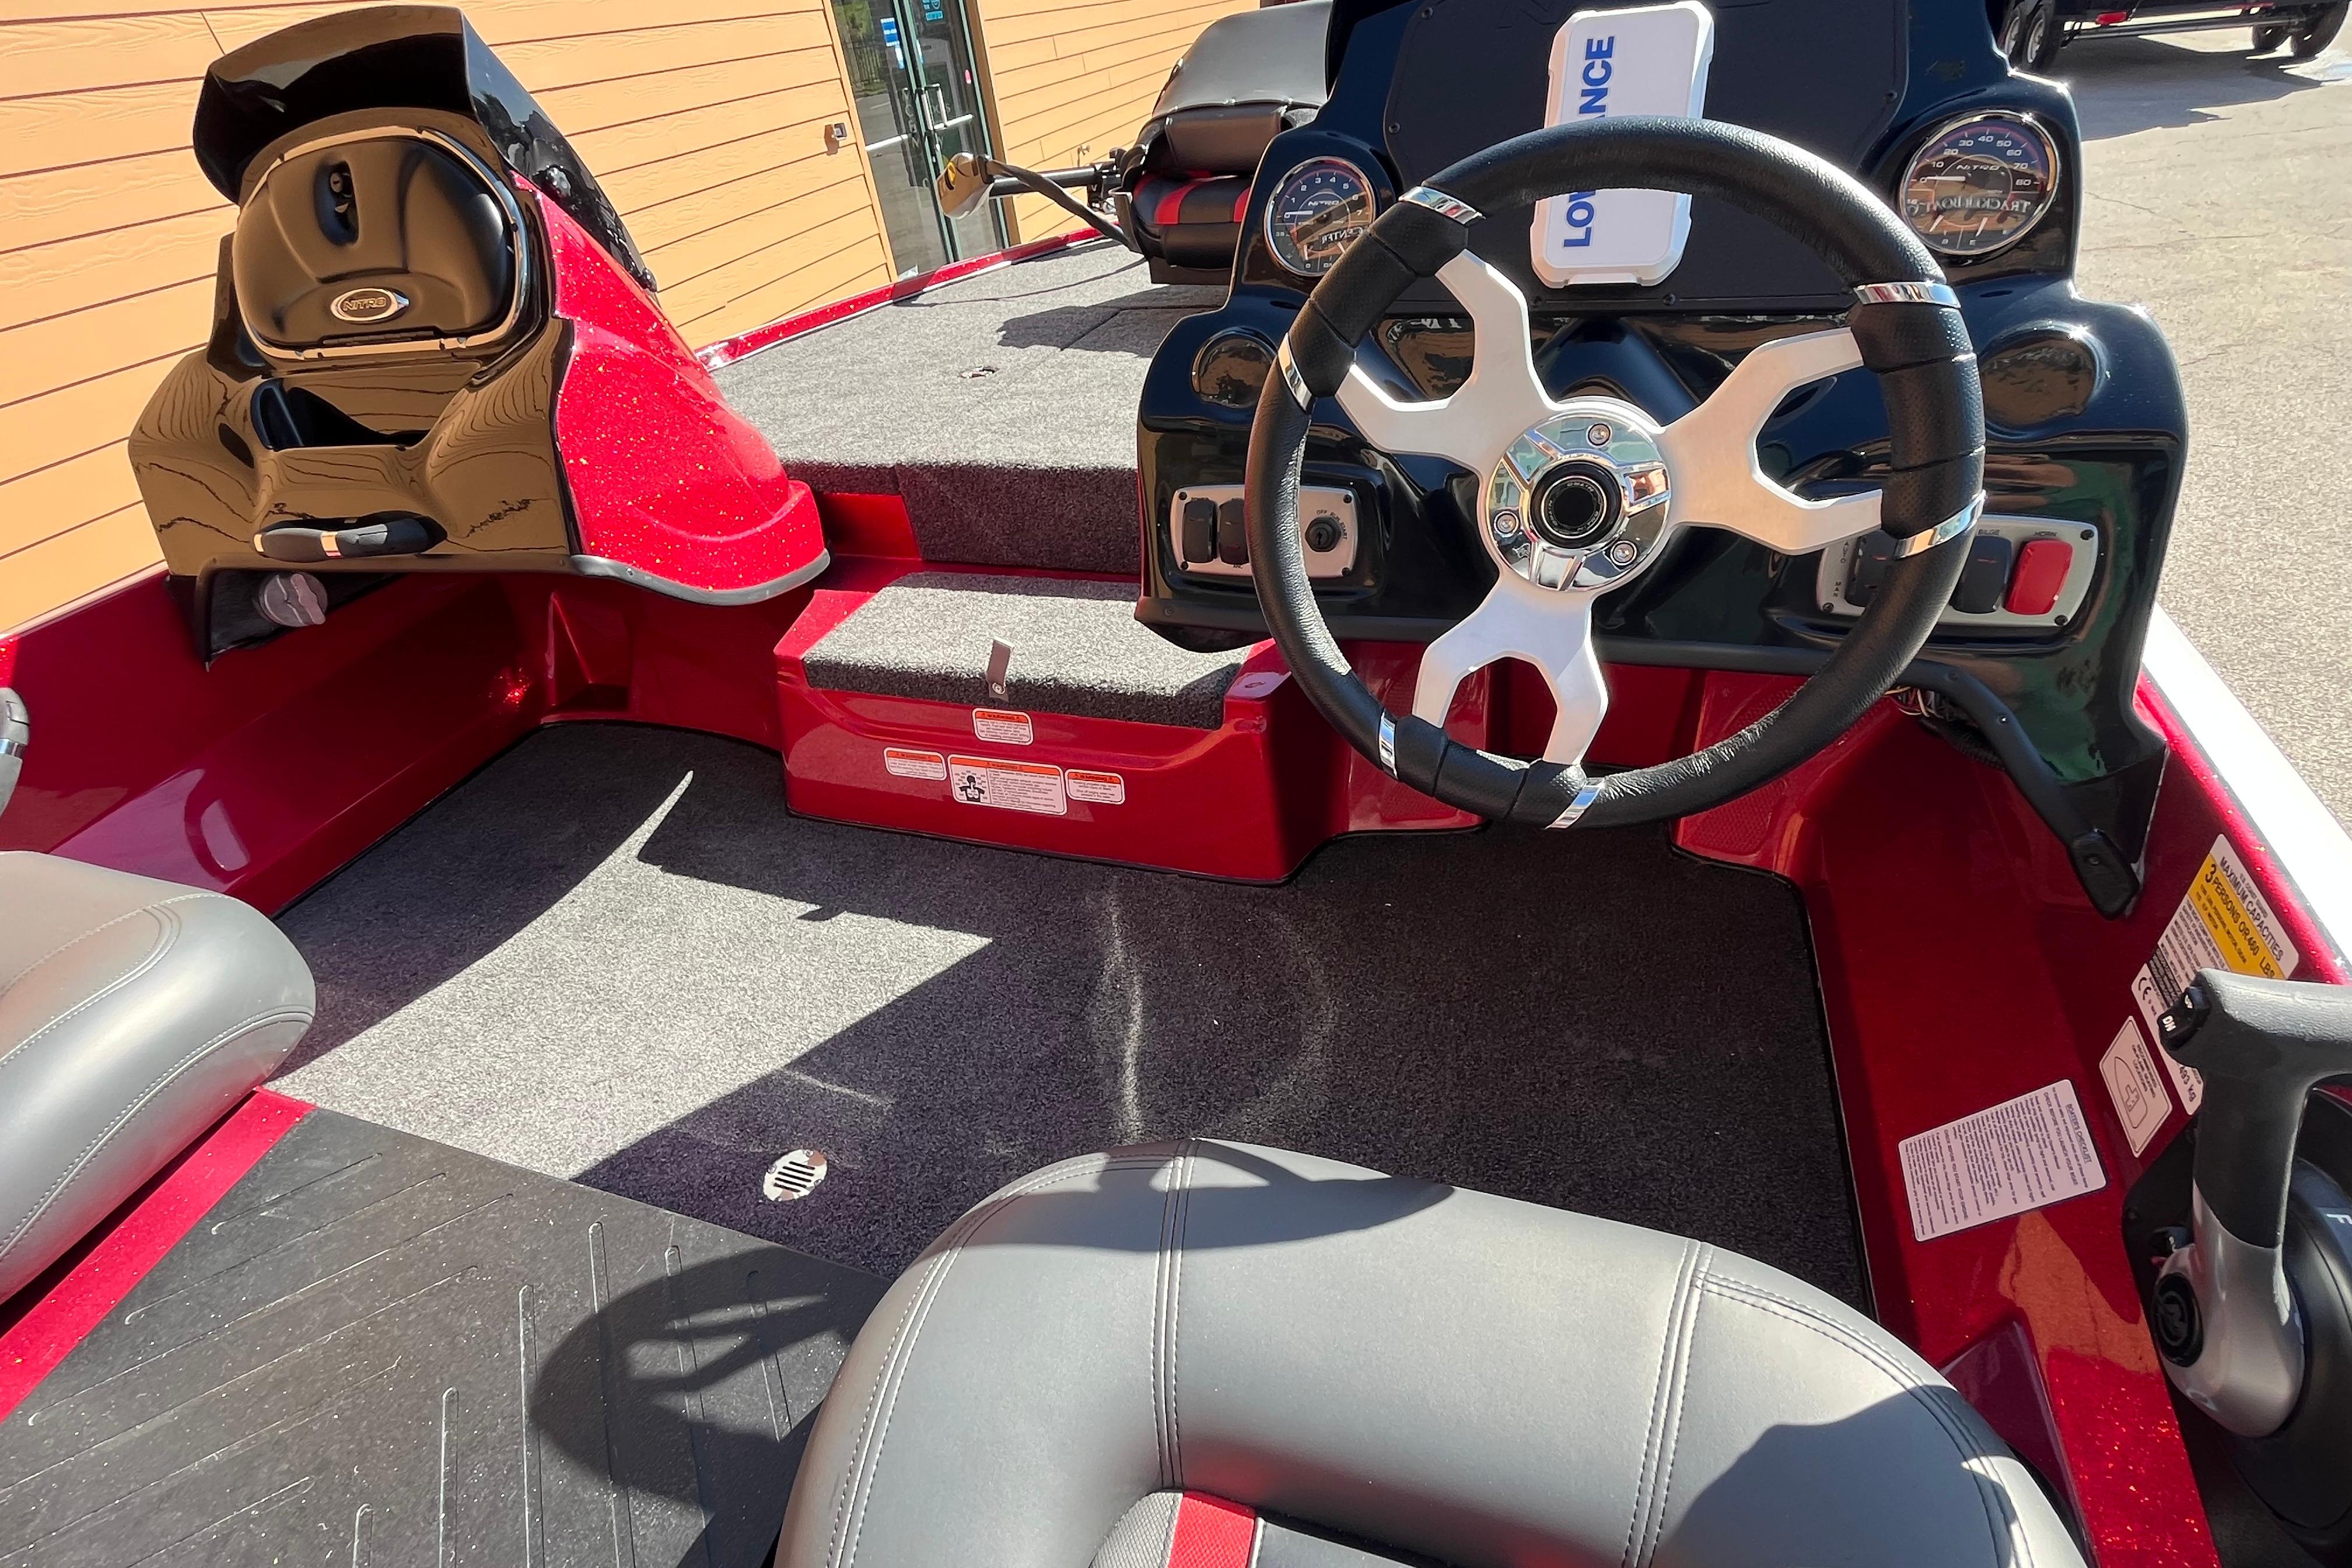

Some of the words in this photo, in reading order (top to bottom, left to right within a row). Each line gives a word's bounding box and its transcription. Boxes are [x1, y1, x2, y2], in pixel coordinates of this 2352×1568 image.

[343, 297, 386, 311] NITRO
[2205, 863, 2217, 883] 3
[2211, 876, 2241, 923] PERSONS
[2238, 921, 2250, 940] OR
[2220, 856, 2248, 904] MAXIMUM
[2246, 901, 2283, 961] CAPACITIES
[2162, 1016, 2176, 1032] DN
[2179, 1062, 2190, 1084] 493
[2188, 1084, 2196, 1102] kg
[2066, 1104, 2080, 1130] BOATER'S
[2076, 1131, 2092, 1164] CHECKLIST
